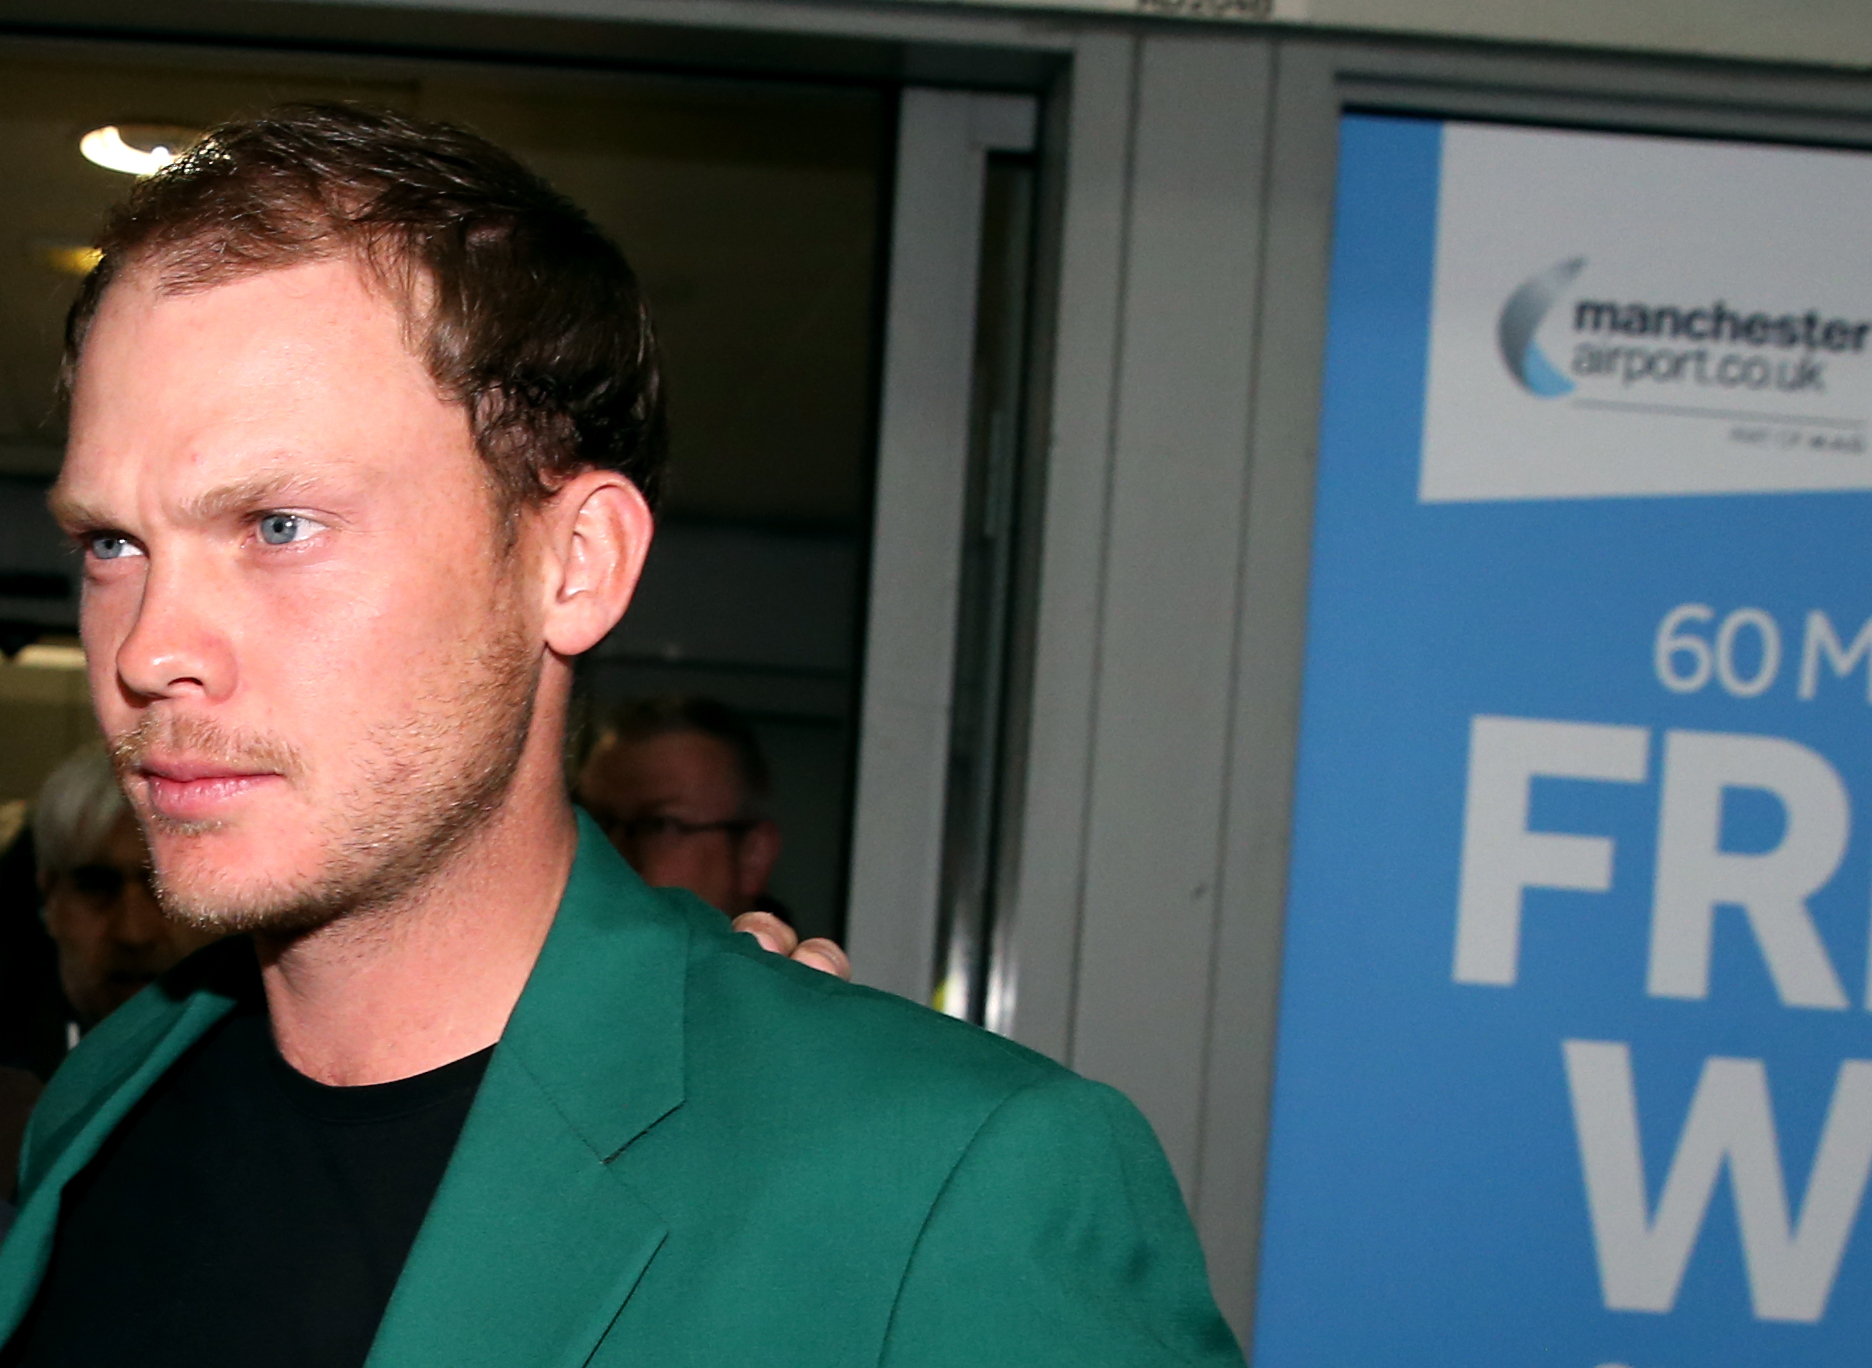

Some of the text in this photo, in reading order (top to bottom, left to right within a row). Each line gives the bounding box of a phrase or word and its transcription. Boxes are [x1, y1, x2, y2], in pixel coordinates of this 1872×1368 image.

[1574, 299, 1869, 354] manchester
[1653, 602, 1783, 698] 60
[1451, 714, 1872, 1012] FR
[1561, 1037, 1872, 1325] W
